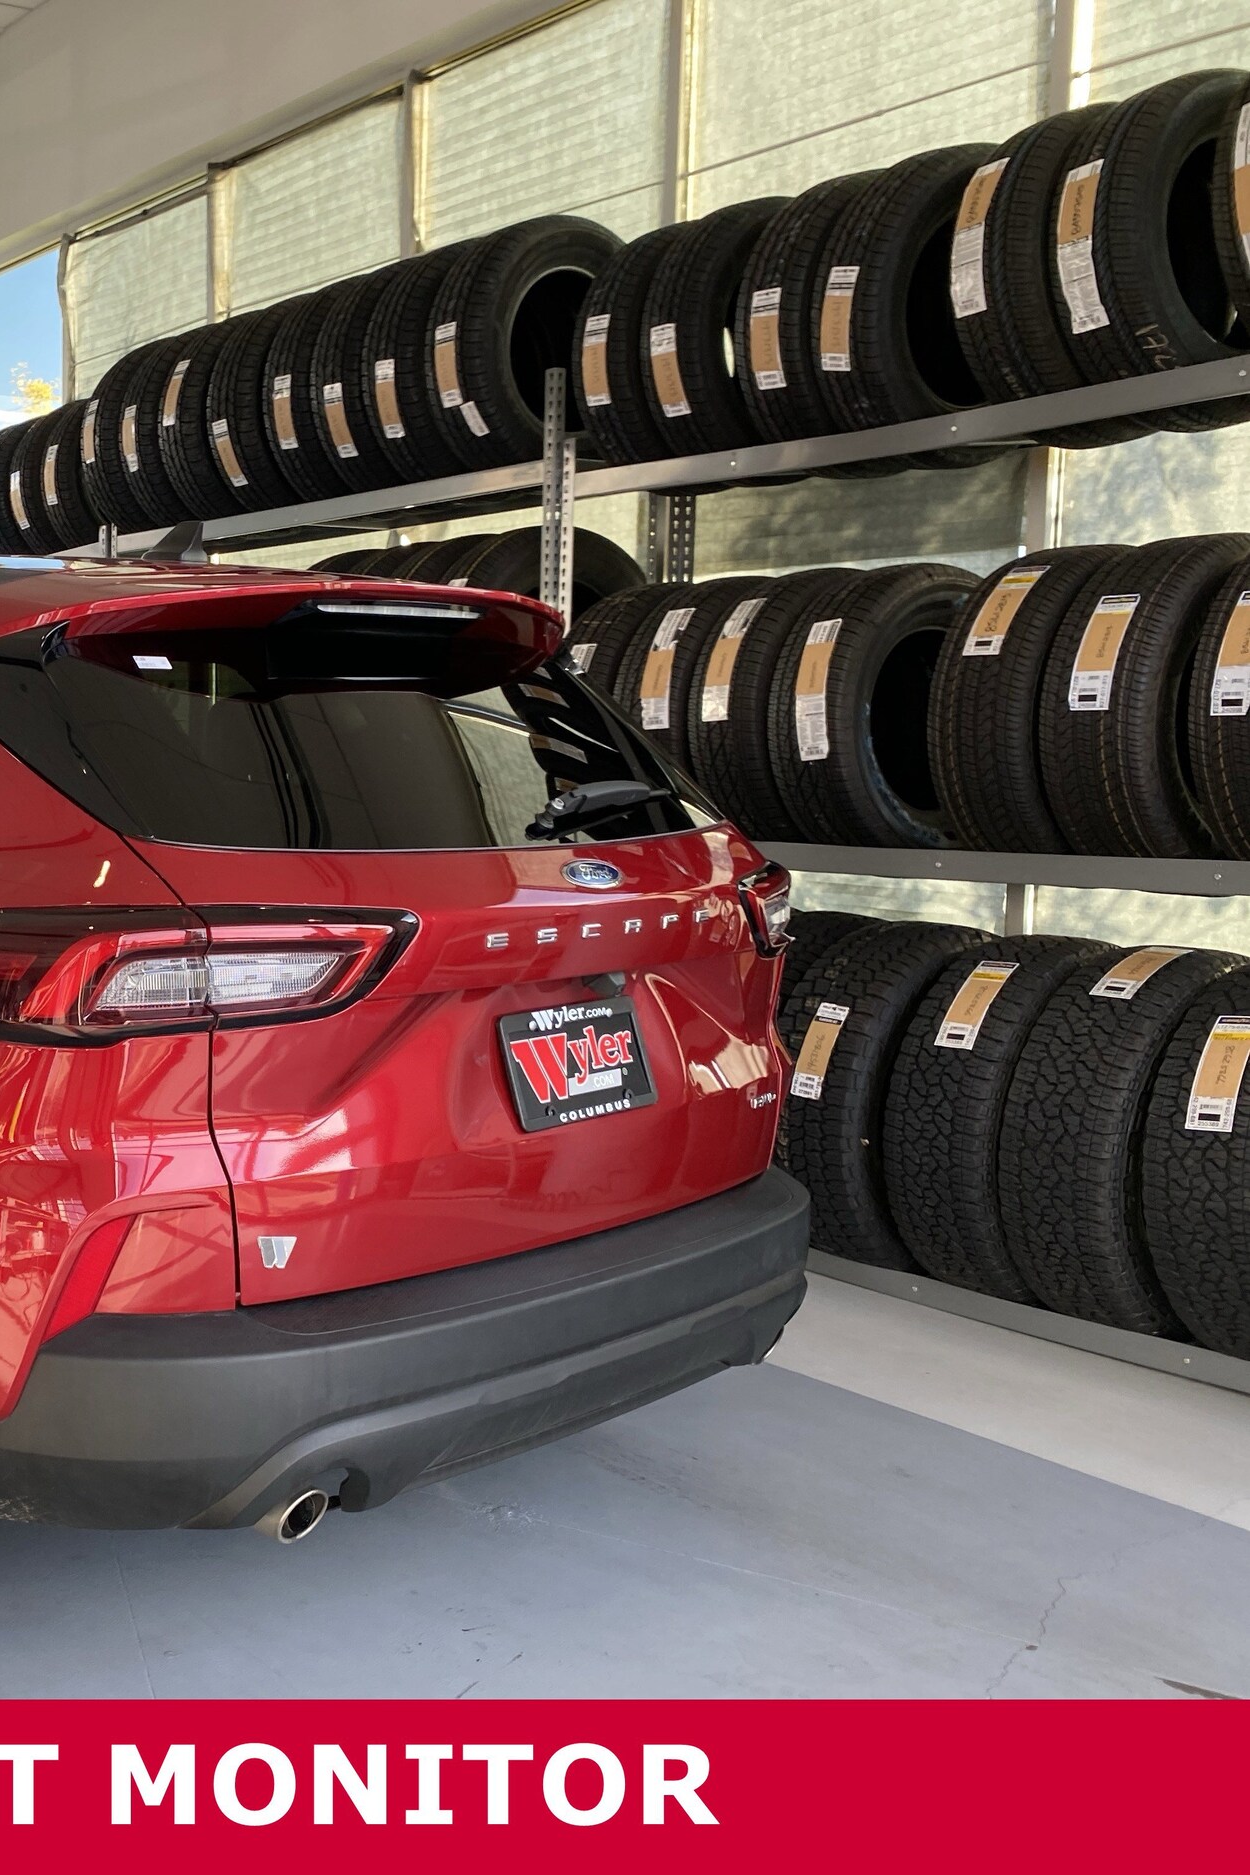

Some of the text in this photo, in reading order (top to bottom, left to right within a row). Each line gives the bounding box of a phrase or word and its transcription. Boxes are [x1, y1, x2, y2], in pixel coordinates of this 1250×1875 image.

[578, 863, 612, 881] Ford
[486, 908, 709, 949] ESCAPE
[510, 1025, 634, 1104] Wyler
[559, 1099, 631, 1123] COLUMBUS
